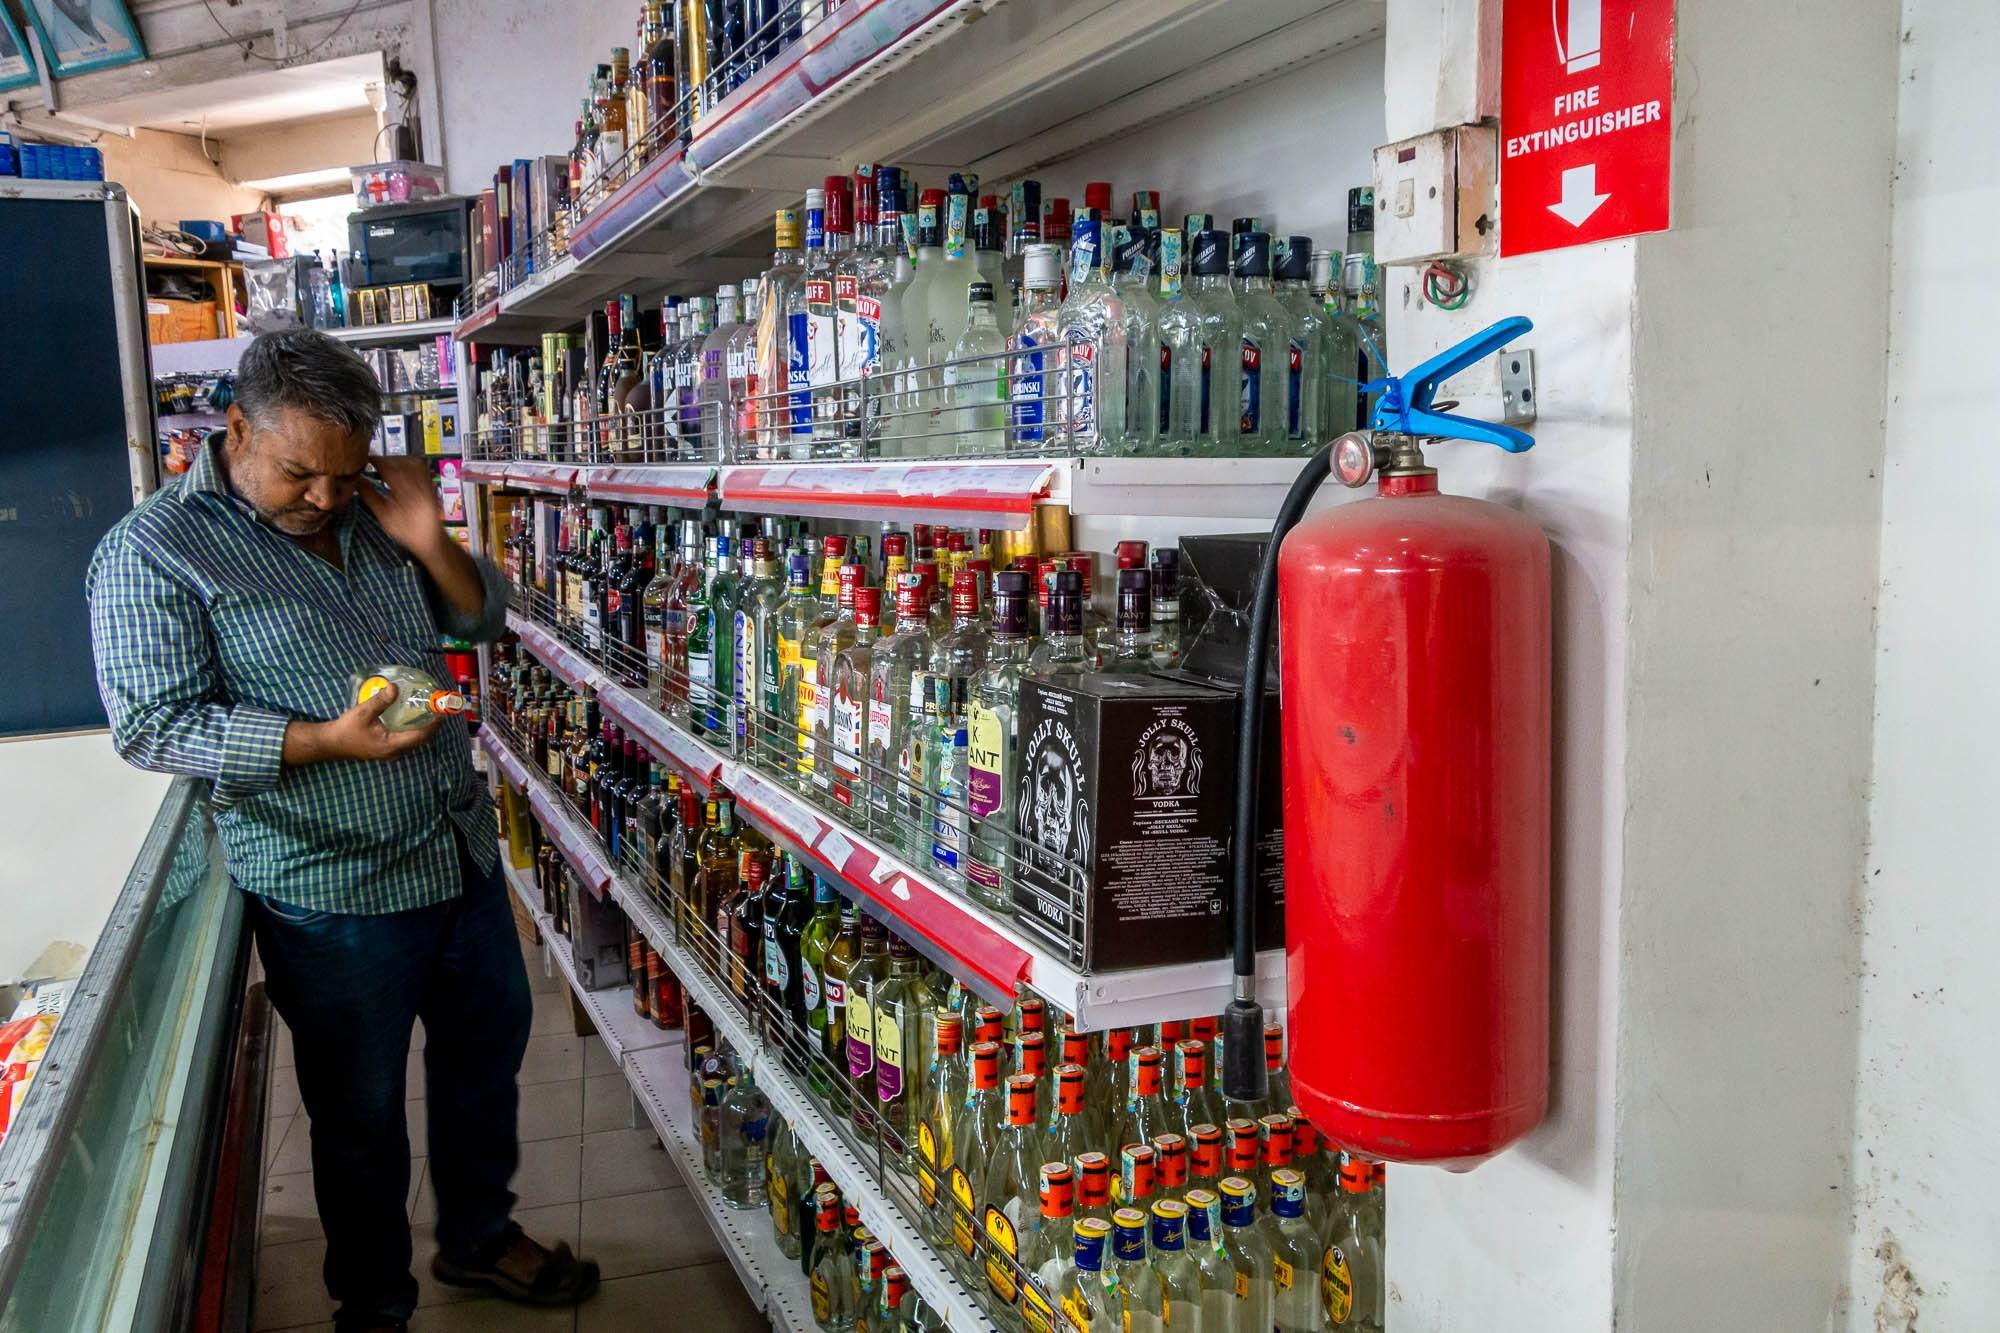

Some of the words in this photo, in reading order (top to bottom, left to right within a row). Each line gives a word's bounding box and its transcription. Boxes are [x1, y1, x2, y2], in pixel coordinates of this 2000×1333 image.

[1553, 85, 1600, 116] FIRE
[1506, 100, 1661, 158] EXTINGUISHER
[807, 283, 826, 299] OFF
[836, 279, 852, 296] OFF
[857, 299, 877, 317] KOV
[788, 369, 810, 382] NSKI
[1138, 718, 1168, 747] JOLLY
[1170, 718, 1200, 746] SKULL
[1025, 718, 1053, 772] JOLLY
[1055, 721, 1086, 792] SKULL
[1153, 800, 1180, 808] VODKA
[1036, 897, 1065, 926] VODKA
